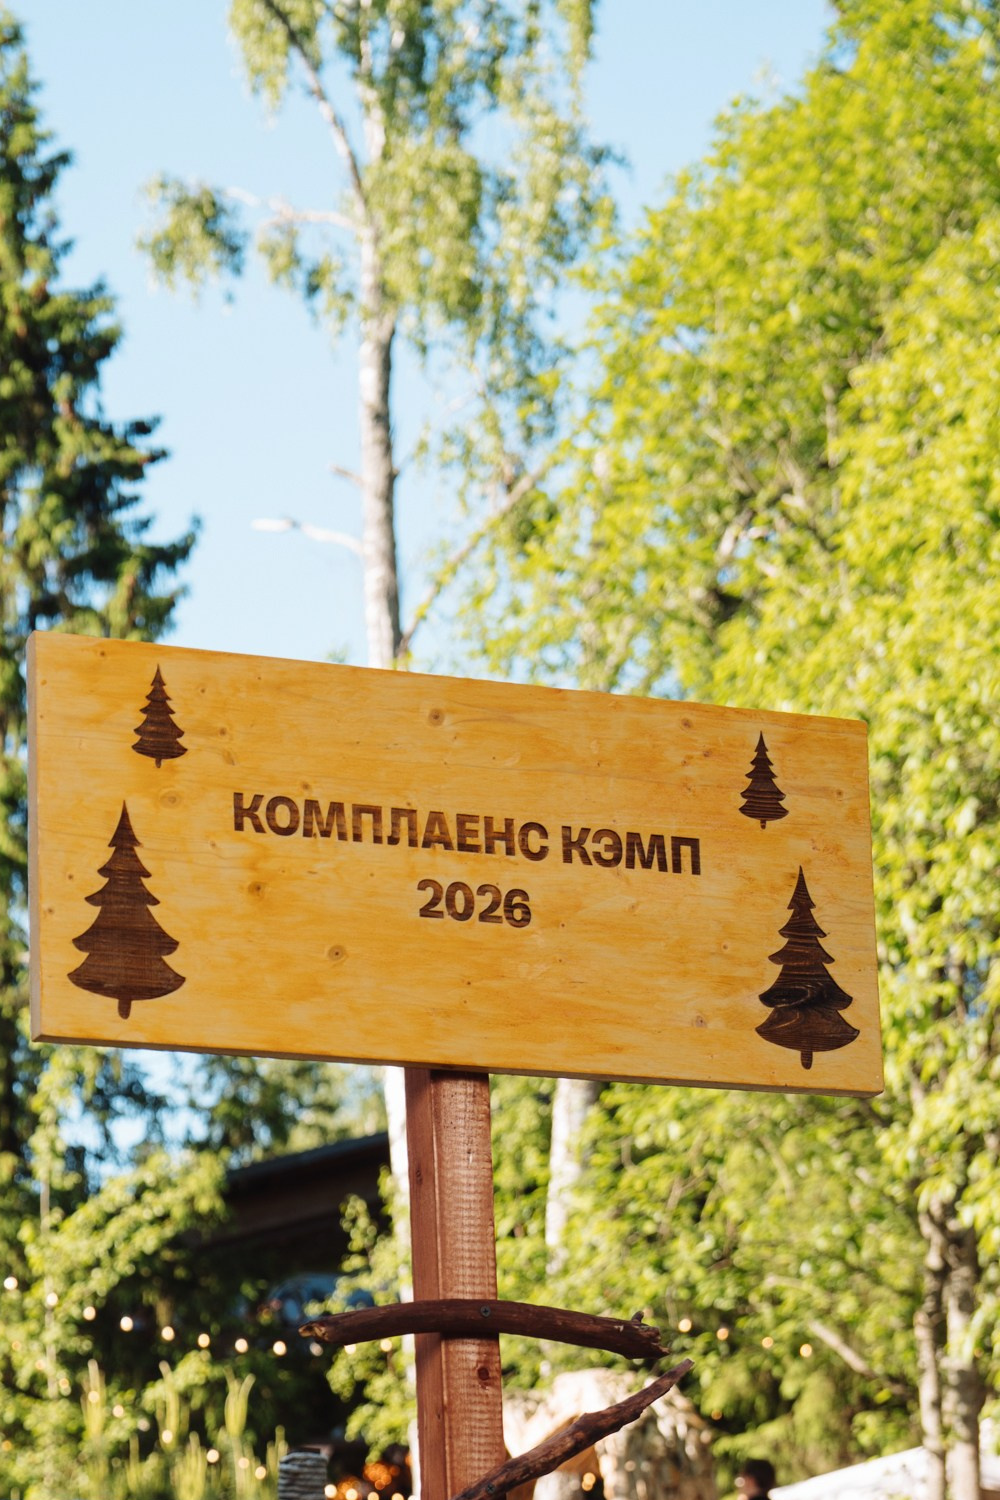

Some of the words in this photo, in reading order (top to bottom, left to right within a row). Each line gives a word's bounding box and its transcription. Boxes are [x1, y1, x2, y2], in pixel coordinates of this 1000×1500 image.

[232, 791, 551, 862] КОМПЛАЕНС
[561, 825, 702, 876] КЭМП
[416, 878, 533, 929] 2026
